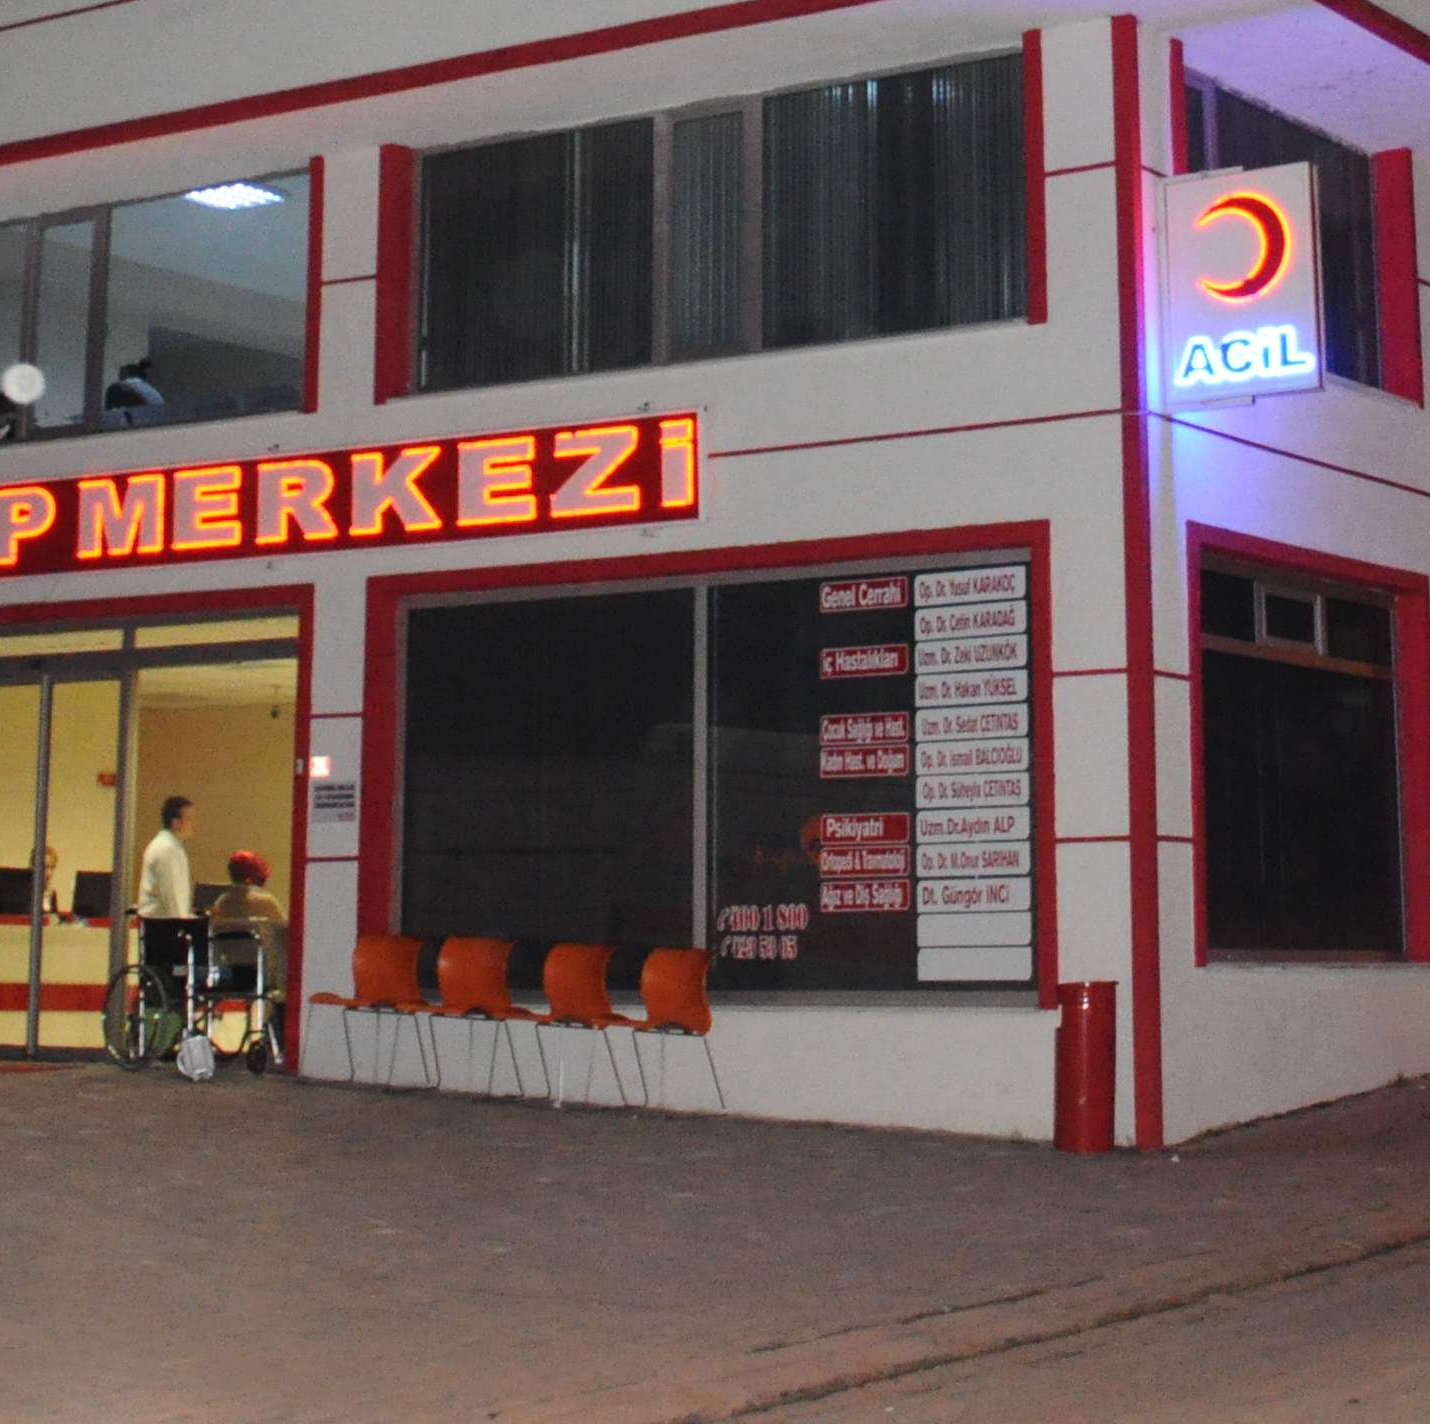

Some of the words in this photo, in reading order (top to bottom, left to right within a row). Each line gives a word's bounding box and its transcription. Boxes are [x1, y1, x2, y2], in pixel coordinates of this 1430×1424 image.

[821, 583, 856, 608] Genel
[858, 581, 902, 606] Cerrahi
[825, 816, 883, 842] Psikiyatri
[993, 815, 1015, 834] ALP
[941, 884, 983, 909] Güngör
